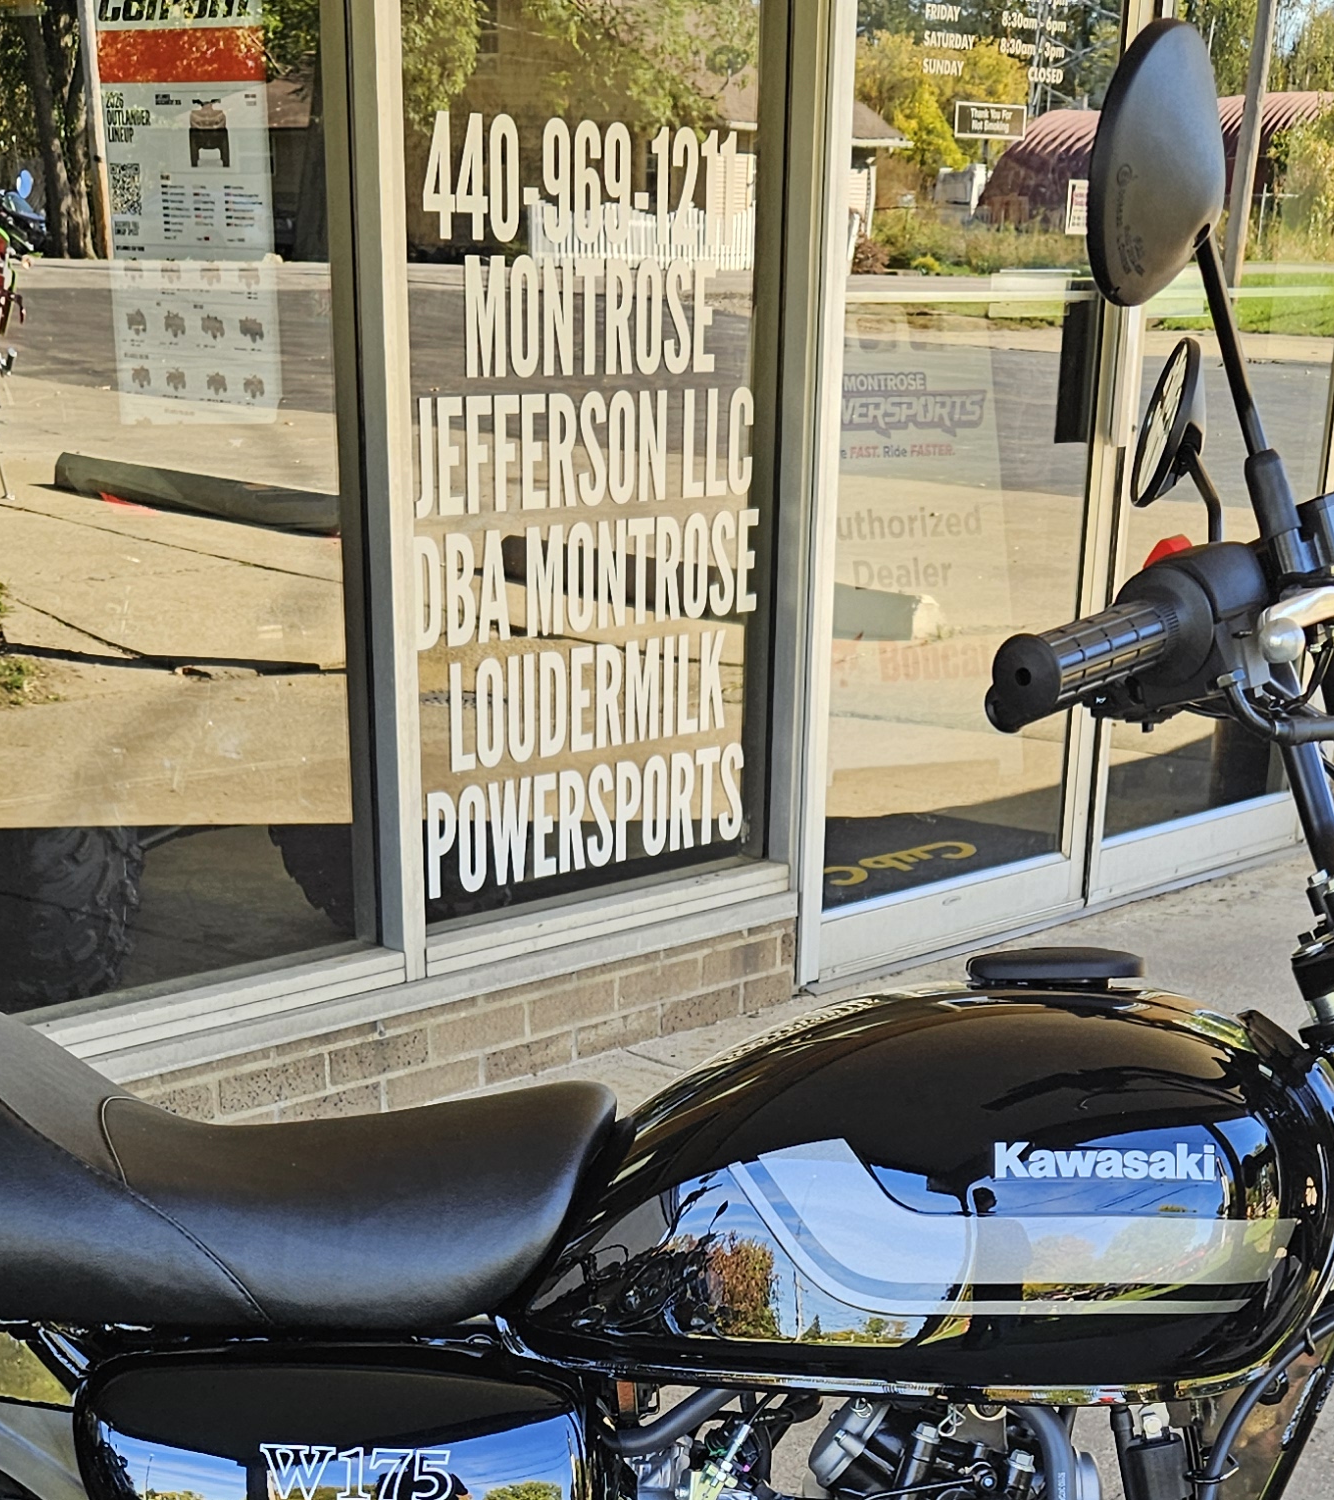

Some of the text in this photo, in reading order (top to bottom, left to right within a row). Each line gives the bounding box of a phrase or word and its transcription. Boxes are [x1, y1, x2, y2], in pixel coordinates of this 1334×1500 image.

[925, 3, 961, 23] FRIDAY
[1001, 10, 1038, 30] 8:30am
[1046, 17, 1067, 33] 6pm
[923, 31, 975, 51] SATURDAY
[999, 38, 1036, 58] 8:30am
[1043, 44, 1065, 60] 3pm
[922, 58, 1063, 84] SUNDAY CLOSED
[107, 127, 135, 143] LINEUP
[423, 110, 737, 246] 440-969-1211
[464, 254, 717, 379] MONTROSE
[843, 372, 926, 391] MONTROSE
[414, 386, 755, 520] JEFFERSON LLC
[850, 445, 881, 459] FAST.
[883, 444, 908, 458] Ride
[910, 443, 956, 457] FASTER.
[837, 505, 983, 541] uthorized
[414, 508, 760, 651] DBA MONTROSE
[852, 556, 952, 588] Dealer
[449, 629, 727, 774] LOUDERMILK
[427, 741, 745, 900] POWERSPORTS
[994, 1141, 1216, 1180] Kawasaki
